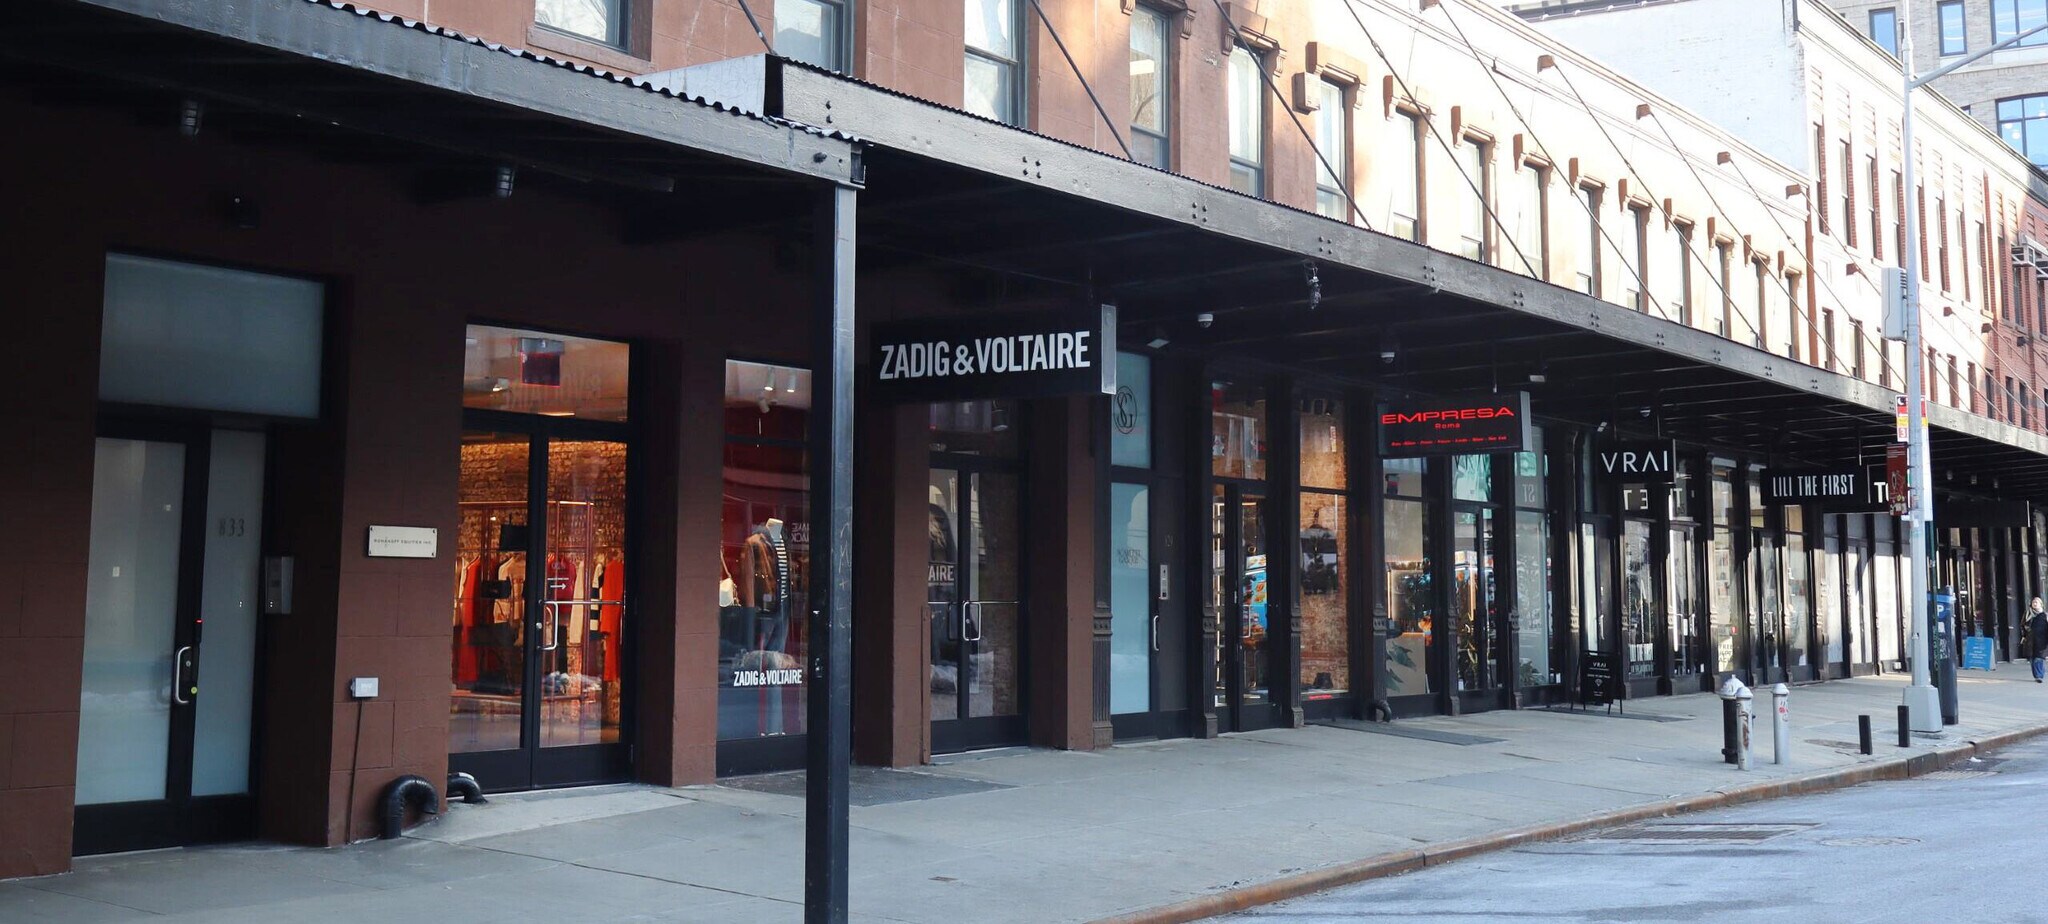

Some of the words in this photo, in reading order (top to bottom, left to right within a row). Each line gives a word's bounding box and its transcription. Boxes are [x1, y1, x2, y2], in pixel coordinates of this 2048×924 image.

[1382, 406, 1514, 424] EMPRESA
[1601, 450, 1668, 473] VRAI
[1773, 476, 1792, 497] LILI
[1797, 475, 1818, 496] THE
[1822, 474, 1854, 495] FIRST
[219, 518, 245, 537] 833
[927, 565, 955, 581] AIRE
